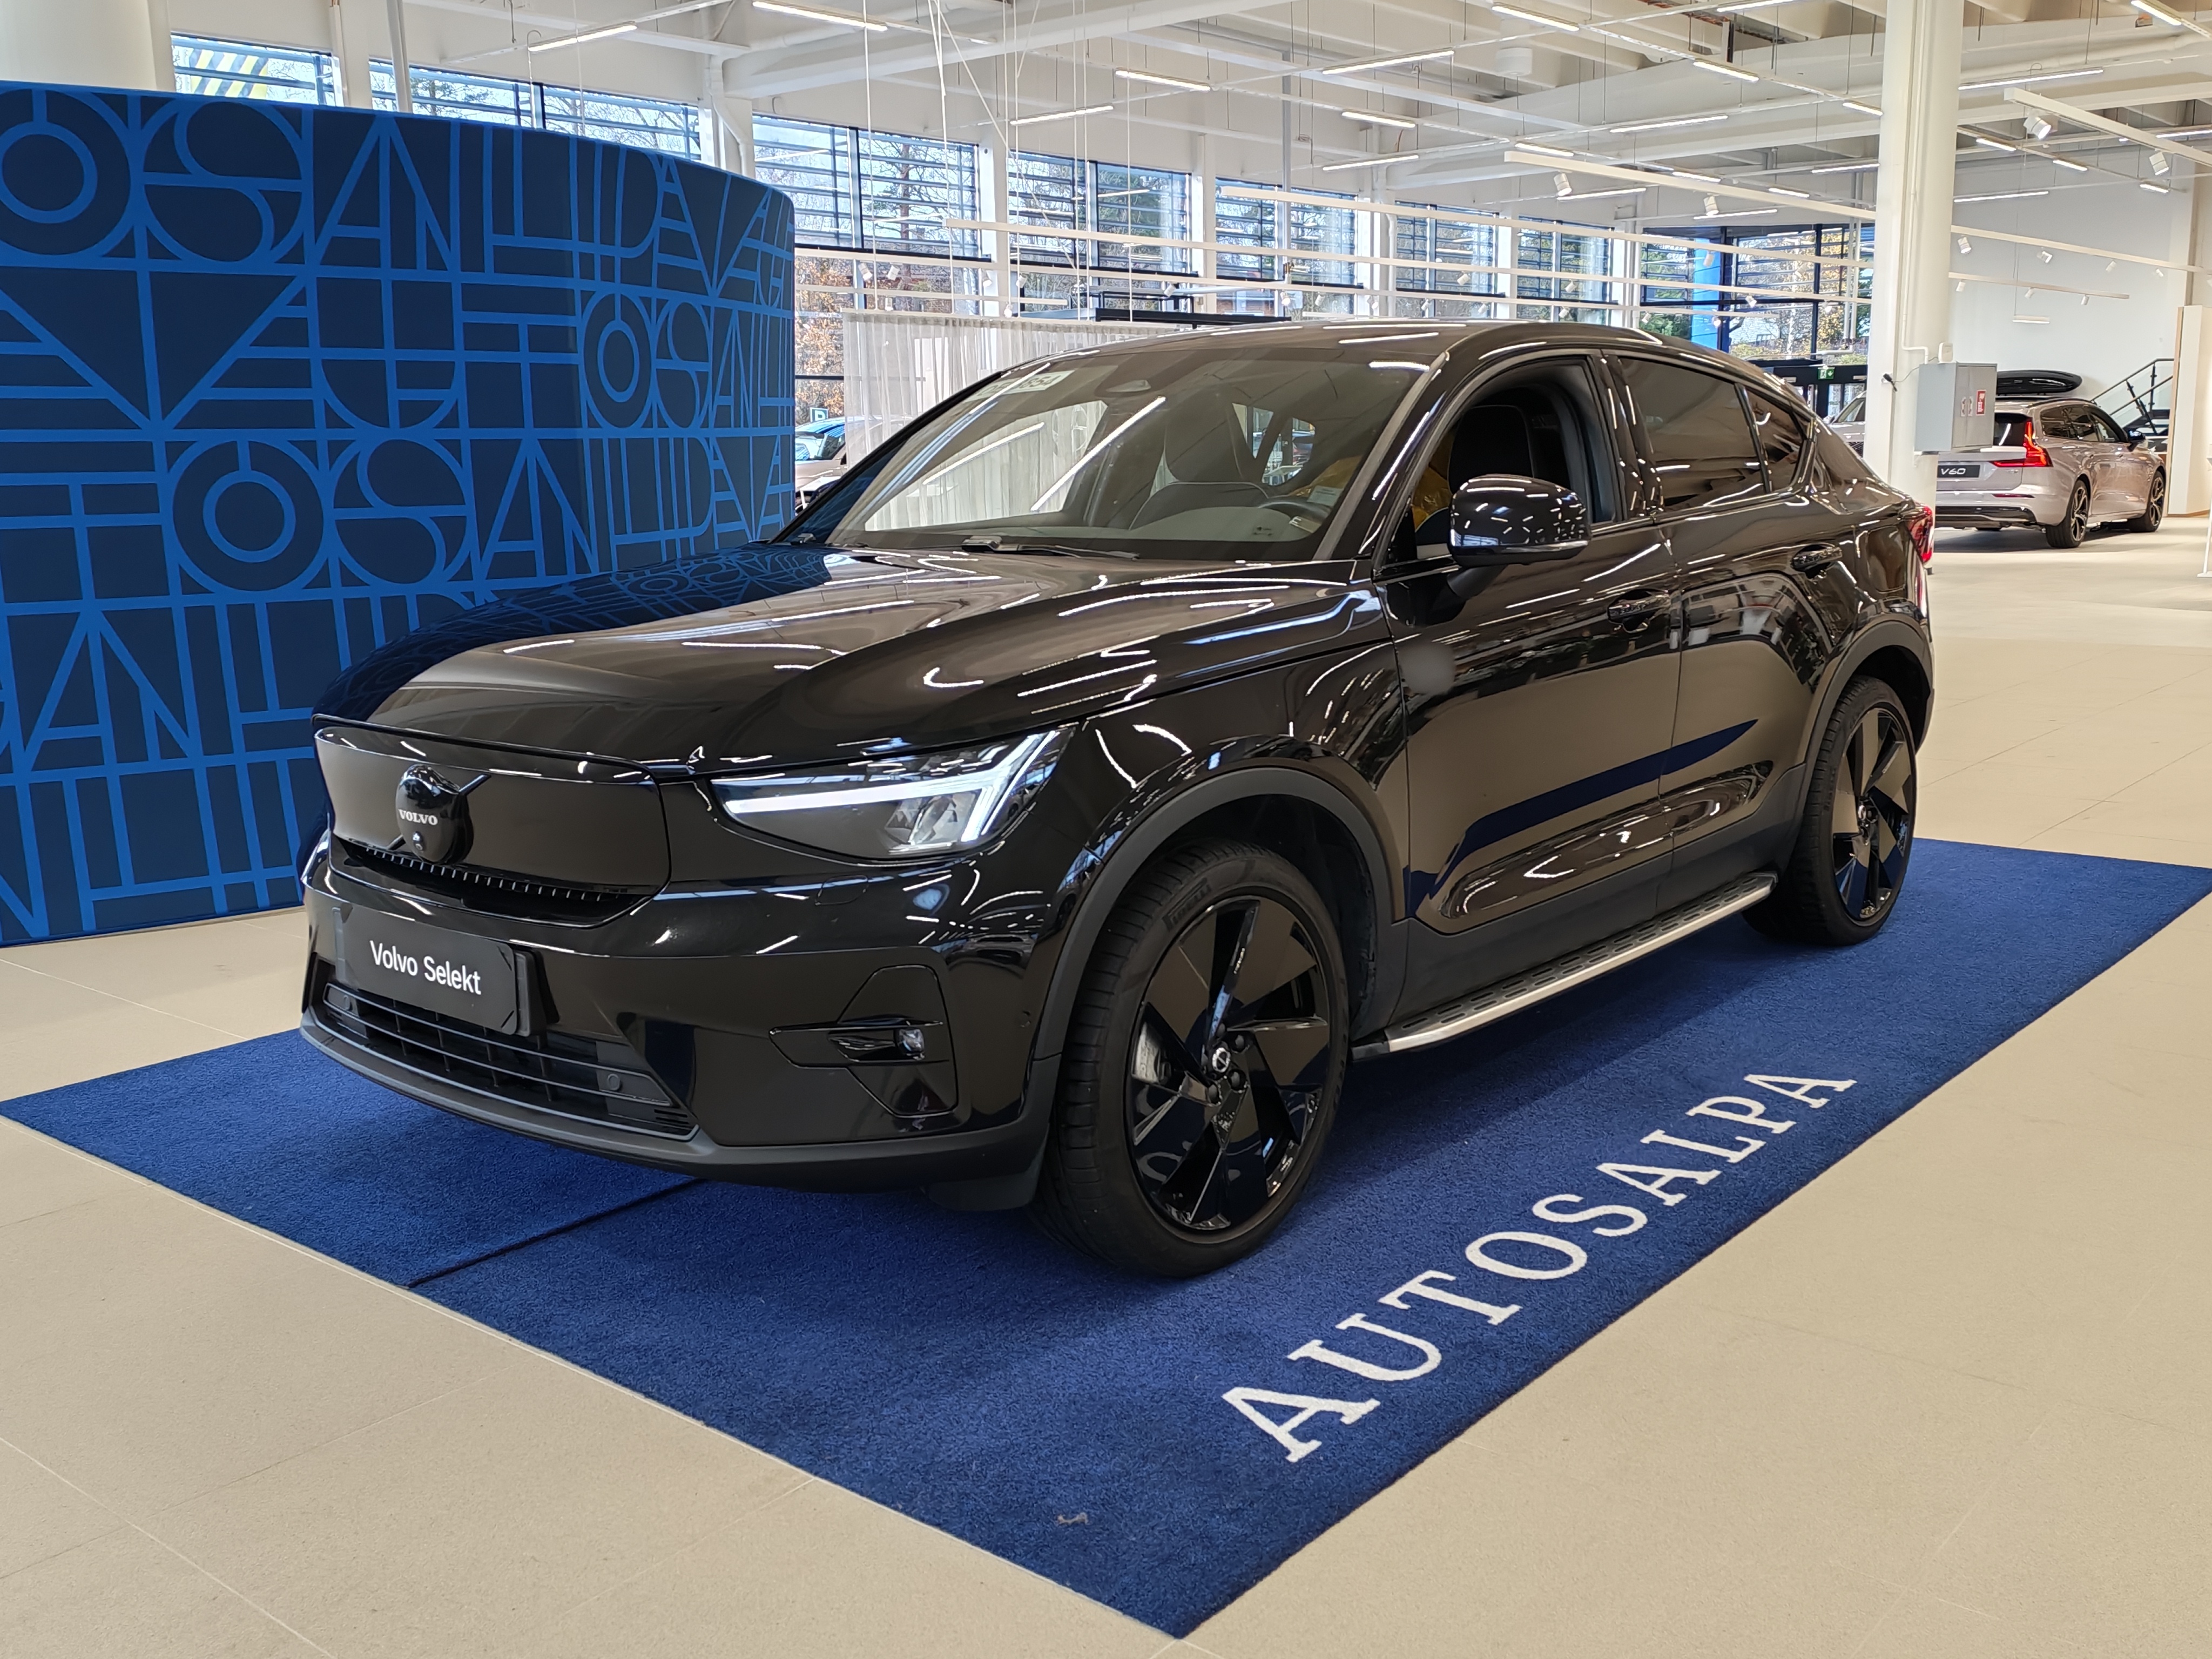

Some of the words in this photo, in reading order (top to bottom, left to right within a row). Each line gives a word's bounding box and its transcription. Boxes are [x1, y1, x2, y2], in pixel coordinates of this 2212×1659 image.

[397, 808, 439, 826] VOLVO
[369, 940, 418, 976] Volvo
[423, 956, 482, 995] Selekt
[1222, 1073, 1858, 1463] AUTOSALPA
